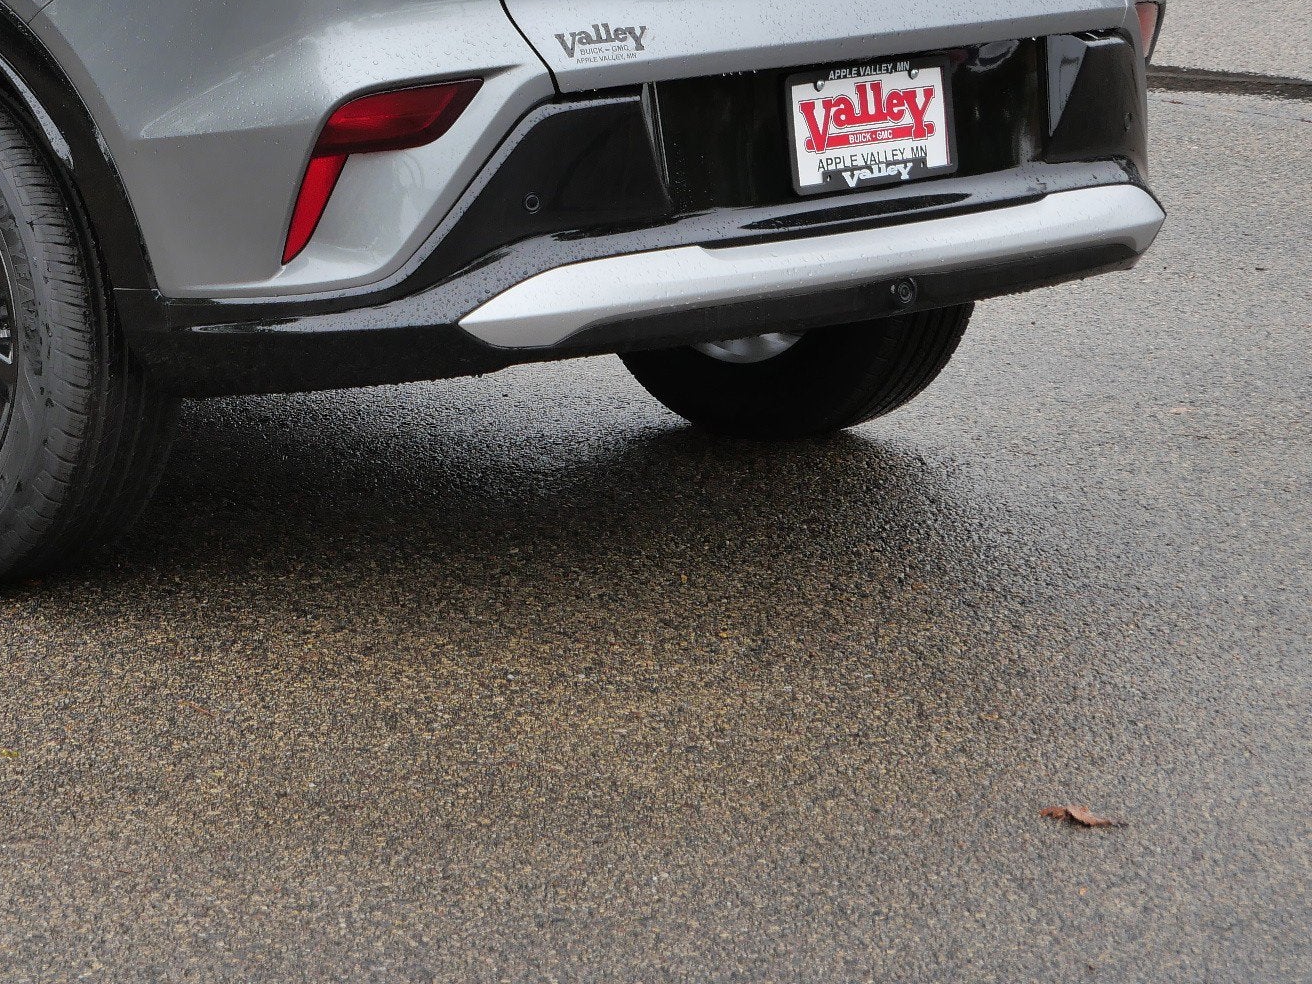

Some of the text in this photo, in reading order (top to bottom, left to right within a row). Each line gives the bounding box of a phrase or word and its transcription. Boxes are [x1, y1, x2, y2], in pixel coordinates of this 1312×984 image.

[554, 22, 647, 58] Valley
[580, 47, 603, 56] BUICK
[828, 60, 910, 80] APPLE VALLEY, MN
[798, 80, 936, 154] Valley
[848, 129, 894, 144] BUICK GMC
[817, 153, 858, 173] APPLE
[910, 144, 927, 158] MN
[841, 162, 913, 188] Valley
